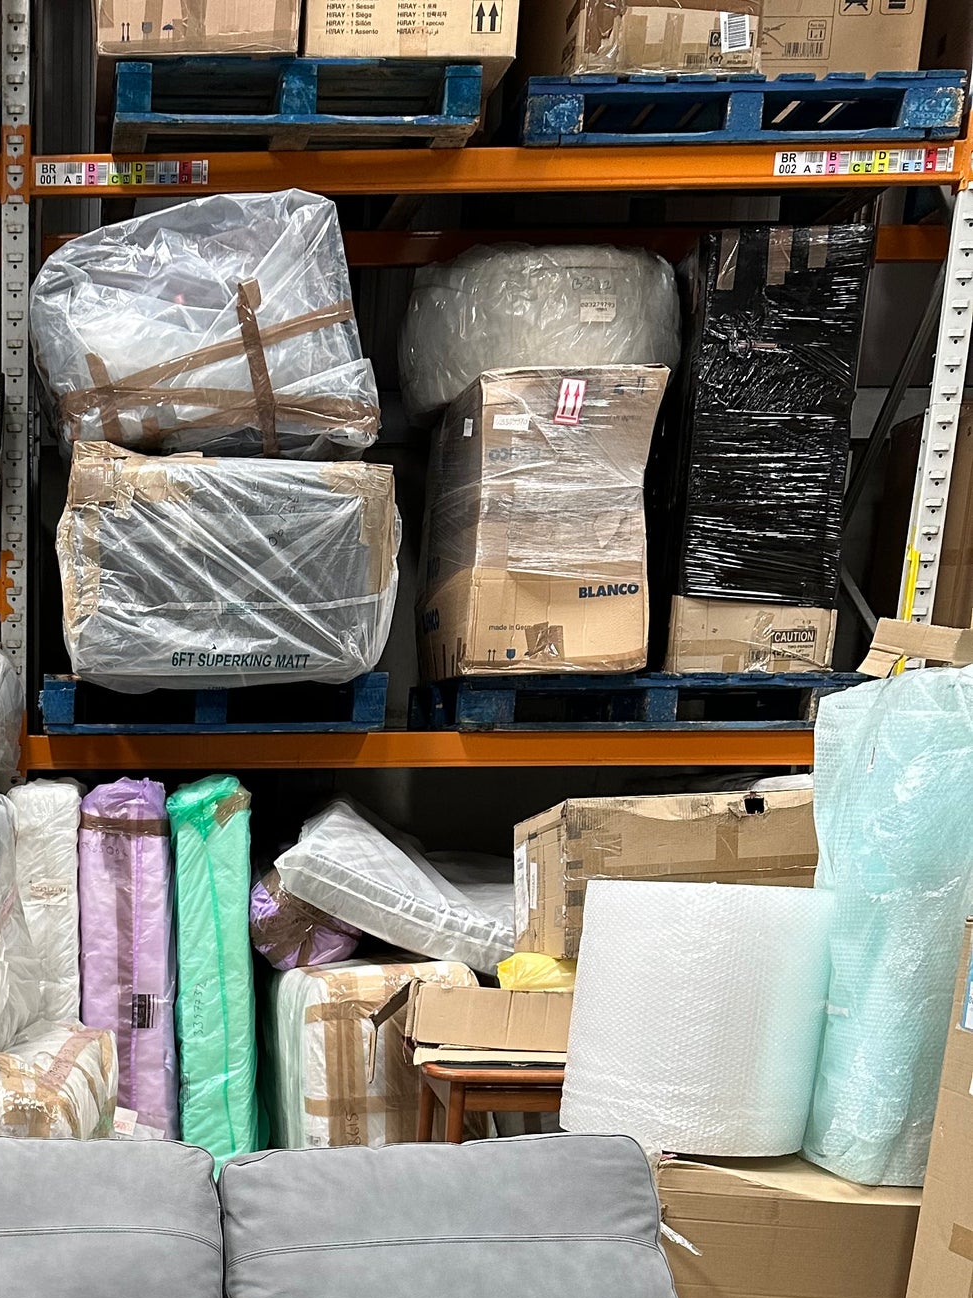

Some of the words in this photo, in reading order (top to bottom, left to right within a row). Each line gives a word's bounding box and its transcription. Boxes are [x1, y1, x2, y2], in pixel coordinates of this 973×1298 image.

[781, 153, 796, 162] BR
[830, 152, 837, 161] B
[42, 164, 56, 174] BR
[88, 164, 95, 172] B
[136, 164, 143, 172] D
[779, 164, 797, 174] 002
[804, 165, 811, 173] A
[853, 164, 860, 172] C
[902, 163, 909, 171] E
[40, 175, 56, 184] 001
[64, 176, 71, 184] A
[112, 176, 119, 184] C
[159, 174, 166, 184] E
[579, 582, 639, 598] BLANCO
[774, 631, 814, 642] CAUTION
[172, 652, 194, 666] 6FT
[197, 653, 272, 667] SUPERKING
[275, 654, 310, 669] MATT
